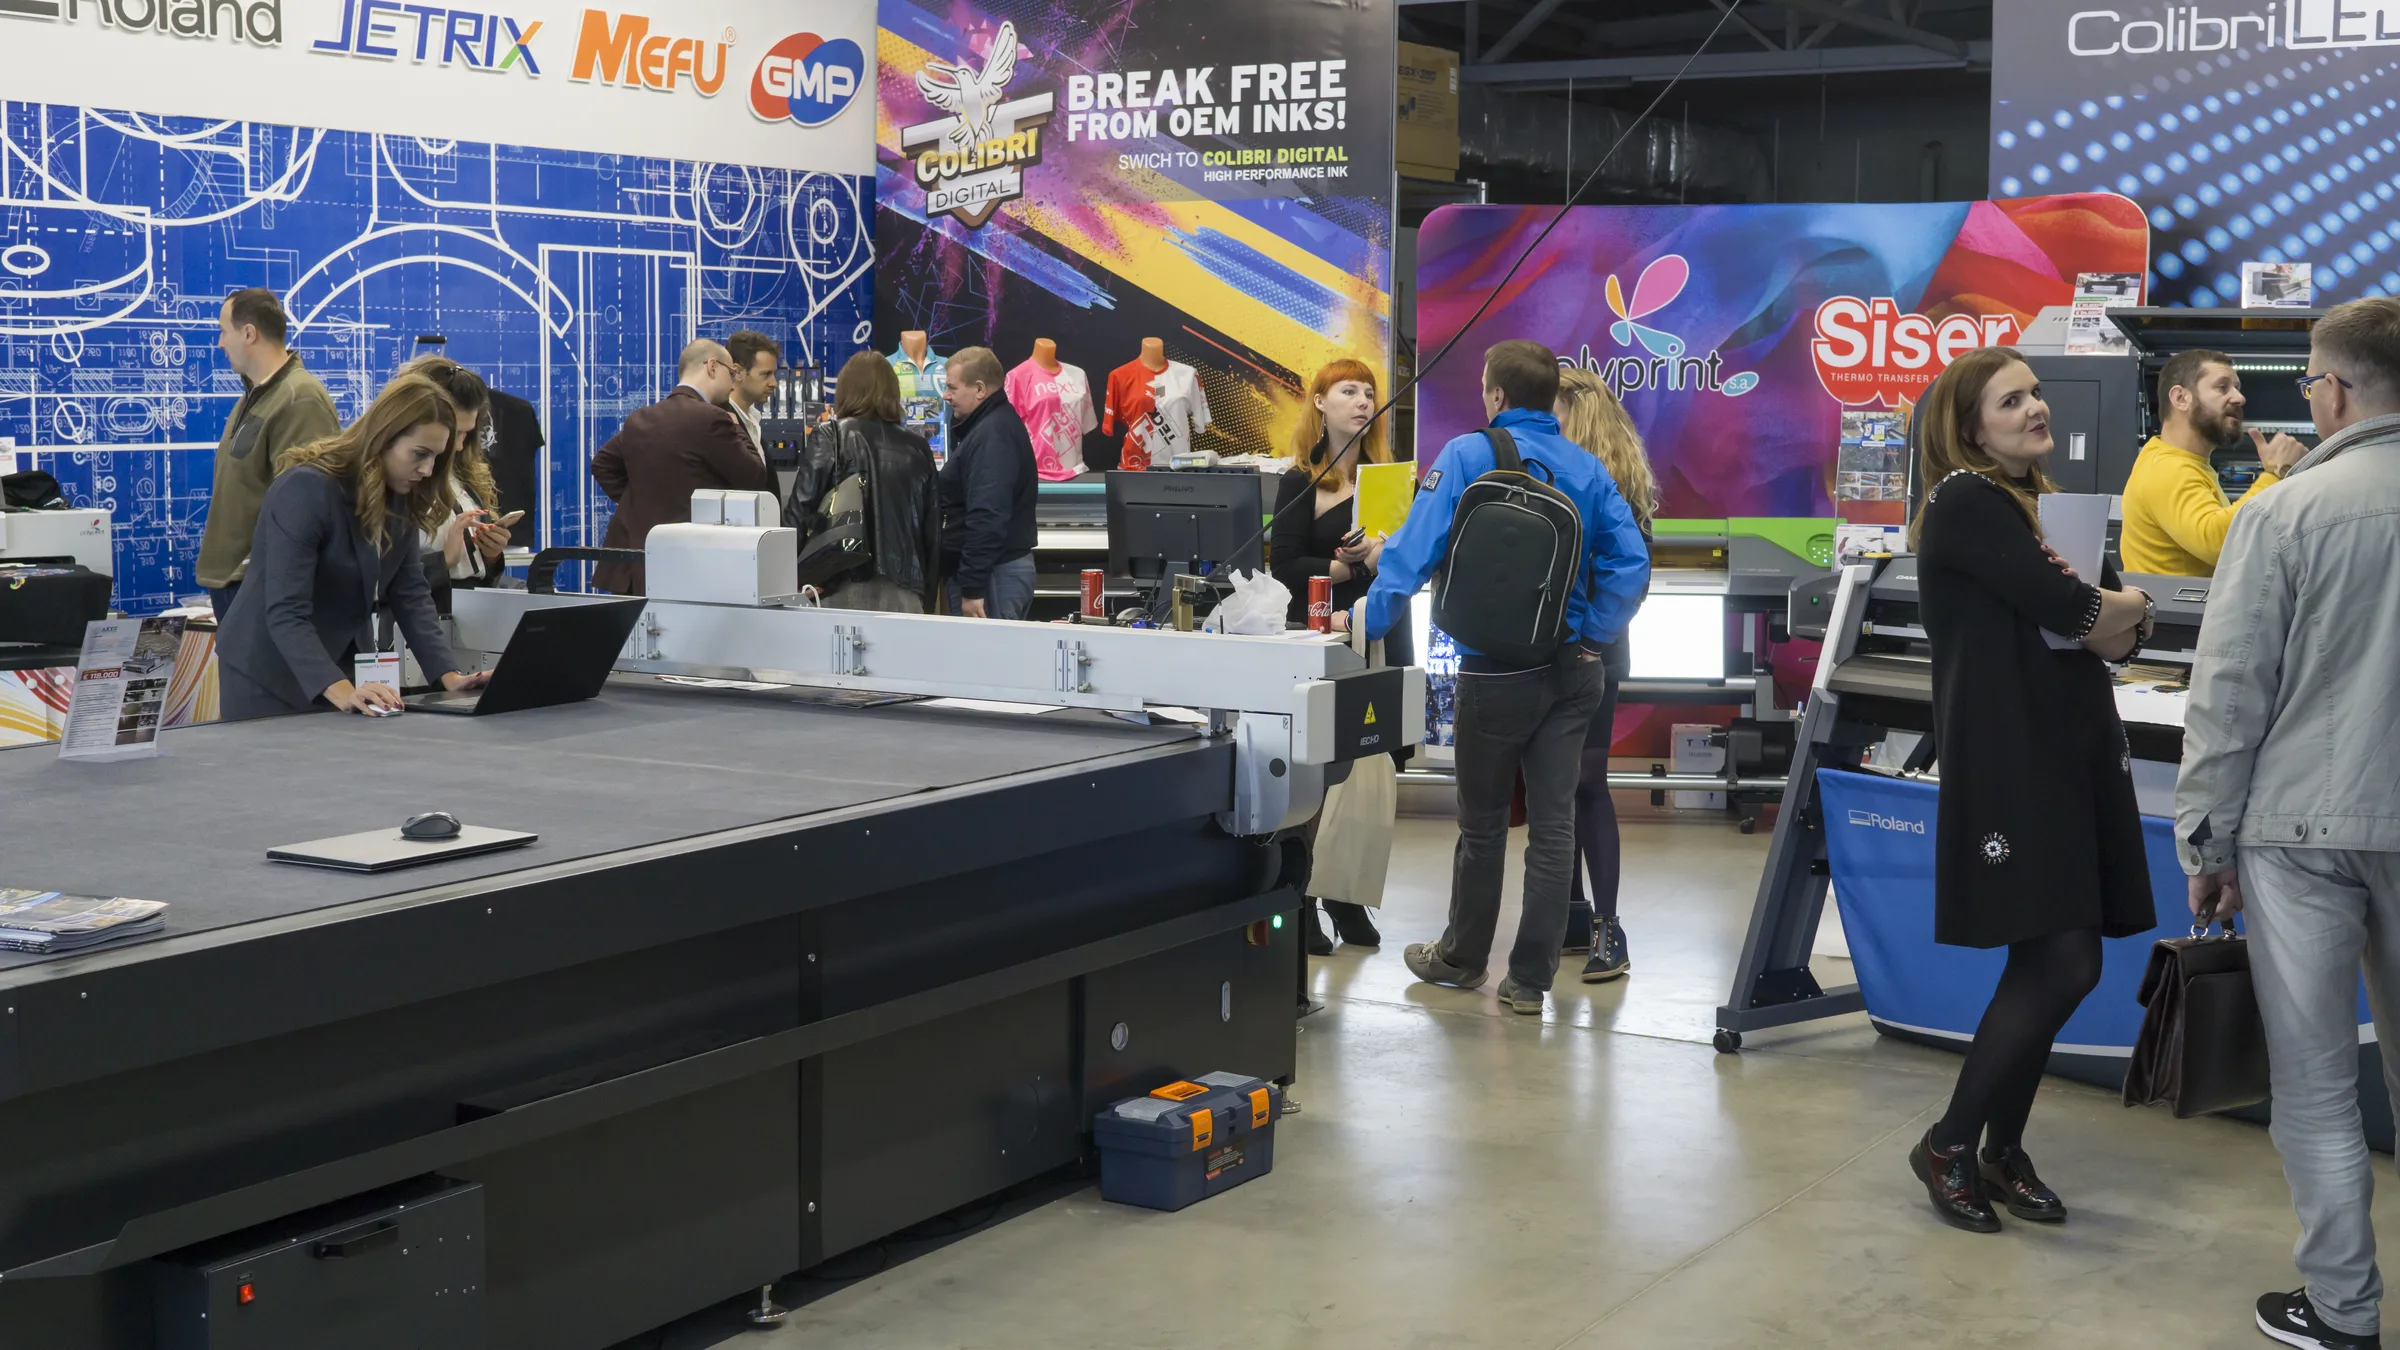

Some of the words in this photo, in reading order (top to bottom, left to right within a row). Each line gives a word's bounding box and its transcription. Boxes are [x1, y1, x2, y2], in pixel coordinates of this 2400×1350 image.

[312, 0, 545, 76] JETRIX
[760, 54, 857, 105] GMP
[1068, 67, 1216, 111] BREAK
[1231, 59, 1347, 103] FREE
[1067, 110, 1158, 142] FROM
[1168, 105, 1240, 137] OEM
[1252, 100, 1347, 133] INKS!
[916, 127, 1039, 183] COLIBRI
[1118, 152, 1173, 170] SWICH
[1175, 152, 1199, 169] TO
[1202, 149, 1272, 167] COLIBRI
[1276, 146, 1349, 164] DIGITAL
[1203, 170, 1232, 182] HIGH
[1234, 167, 1325, 181] PERFORMANCE
[1327, 166, 1349, 178] INK
[935, 179, 1011, 208] DIGITAL
[1816, 301, 2012, 370] Siser
[1034, 380, 1079, 398] next
[1831, 372, 1873, 382] THERMO
[1878, 374, 1929, 383] TRANSFER
[1870, 812, 1925, 834] Roland
